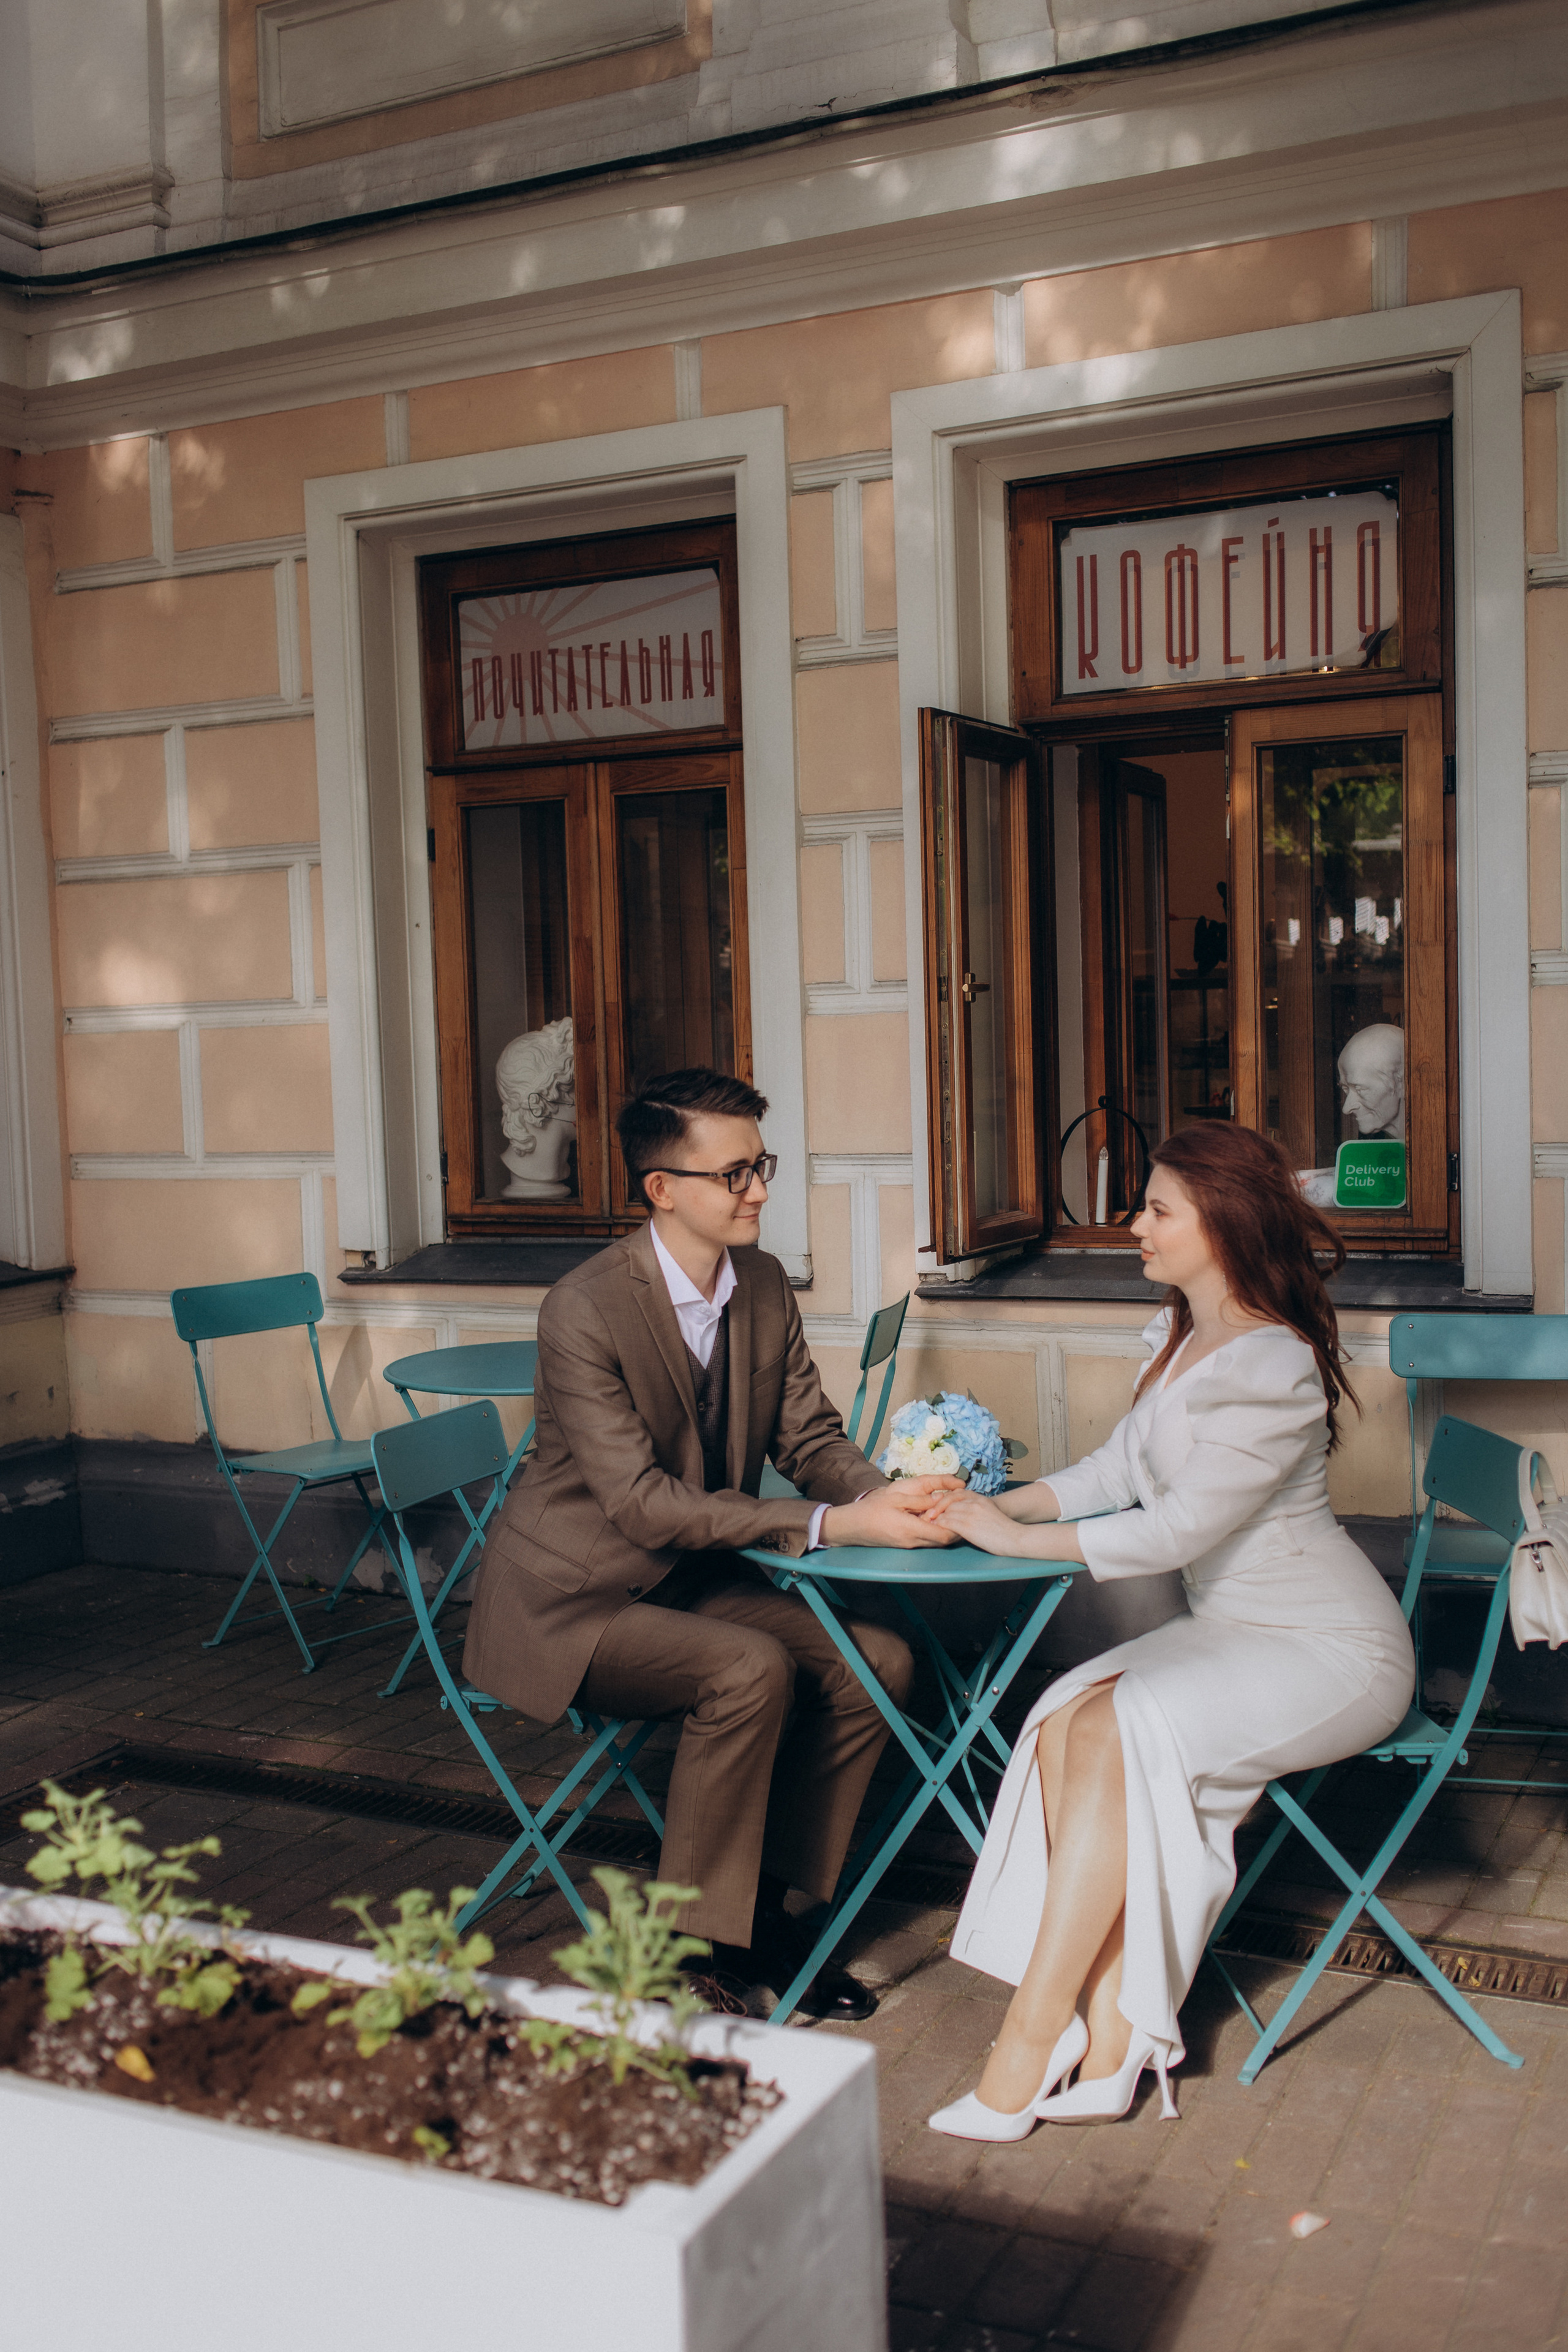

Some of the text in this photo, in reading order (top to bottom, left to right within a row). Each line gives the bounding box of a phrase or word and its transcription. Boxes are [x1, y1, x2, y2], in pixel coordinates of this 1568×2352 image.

[1076, 517, 1381, 680] КОФЕЙНЯ
[472, 630, 715, 722] ПОЧИТАТЕЛЬНАЯ
[1344, 1177, 1375, 1186] Club
[1346, 1164, 1400, 1176] Delivery
